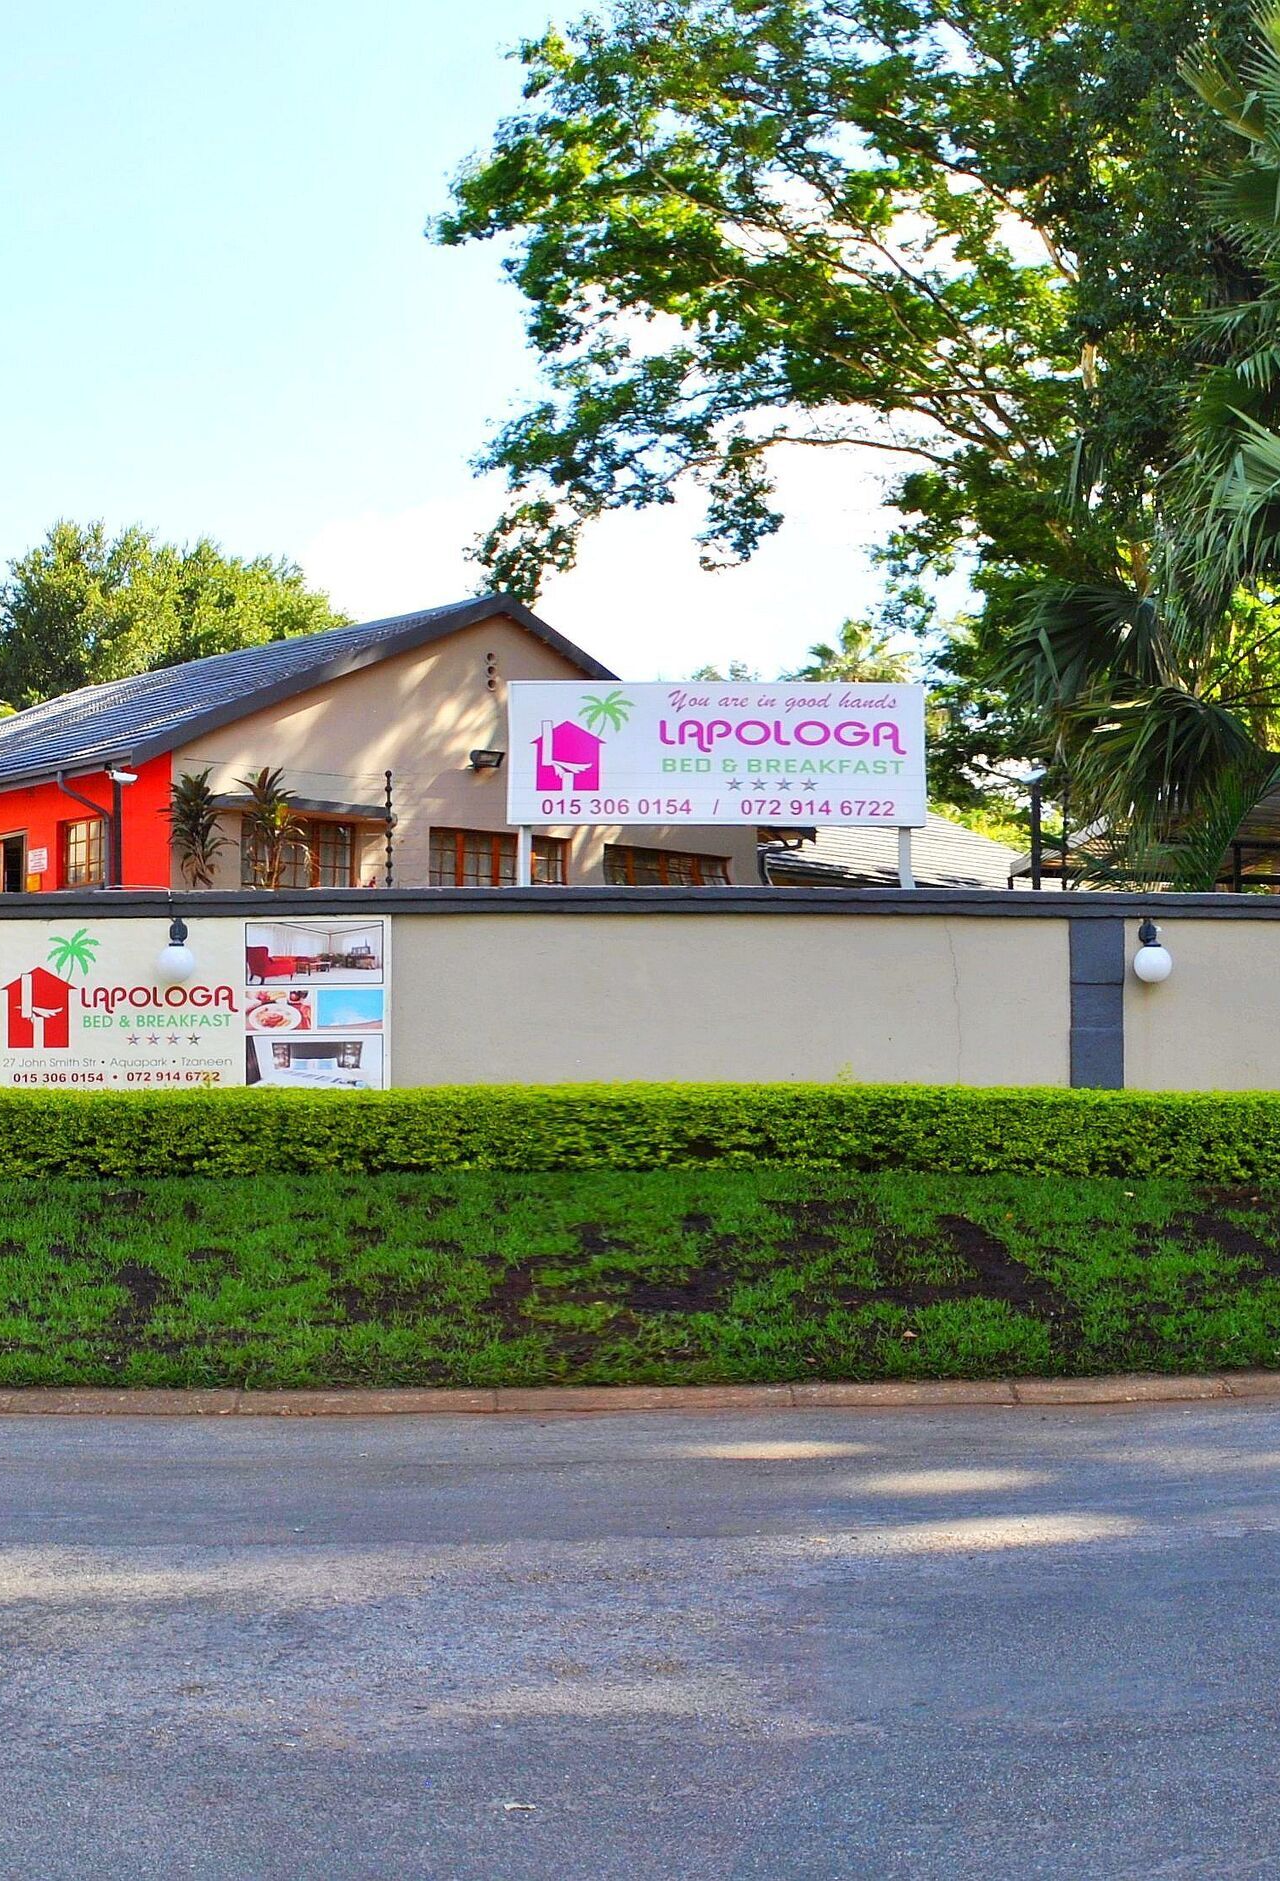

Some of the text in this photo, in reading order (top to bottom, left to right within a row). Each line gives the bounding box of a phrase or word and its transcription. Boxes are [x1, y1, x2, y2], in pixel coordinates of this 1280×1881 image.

[668, 689, 898, 713] You are in good hands
[659, 719, 907, 755] LAPOLOGA
[662, 758, 905, 775] BED & BREAKFAST
[542, 798, 582, 815] 015
[590, 798, 630, 815] 306
[638, 798, 692, 815] 0154
[741, 799, 781, 815] 072
[790, 799, 832, 816] 914
[840, 800, 895, 817] 6722
[81, 985, 239, 1014] LAPOLOGA
[83, 1014, 231, 1028] BED & BREAKFAST
[3, 1056, 233, 1069] 27 John Smith Str Aquapark Tzaneen
[13, 1072, 220, 1083] 015 306 0154 072 914 6722
